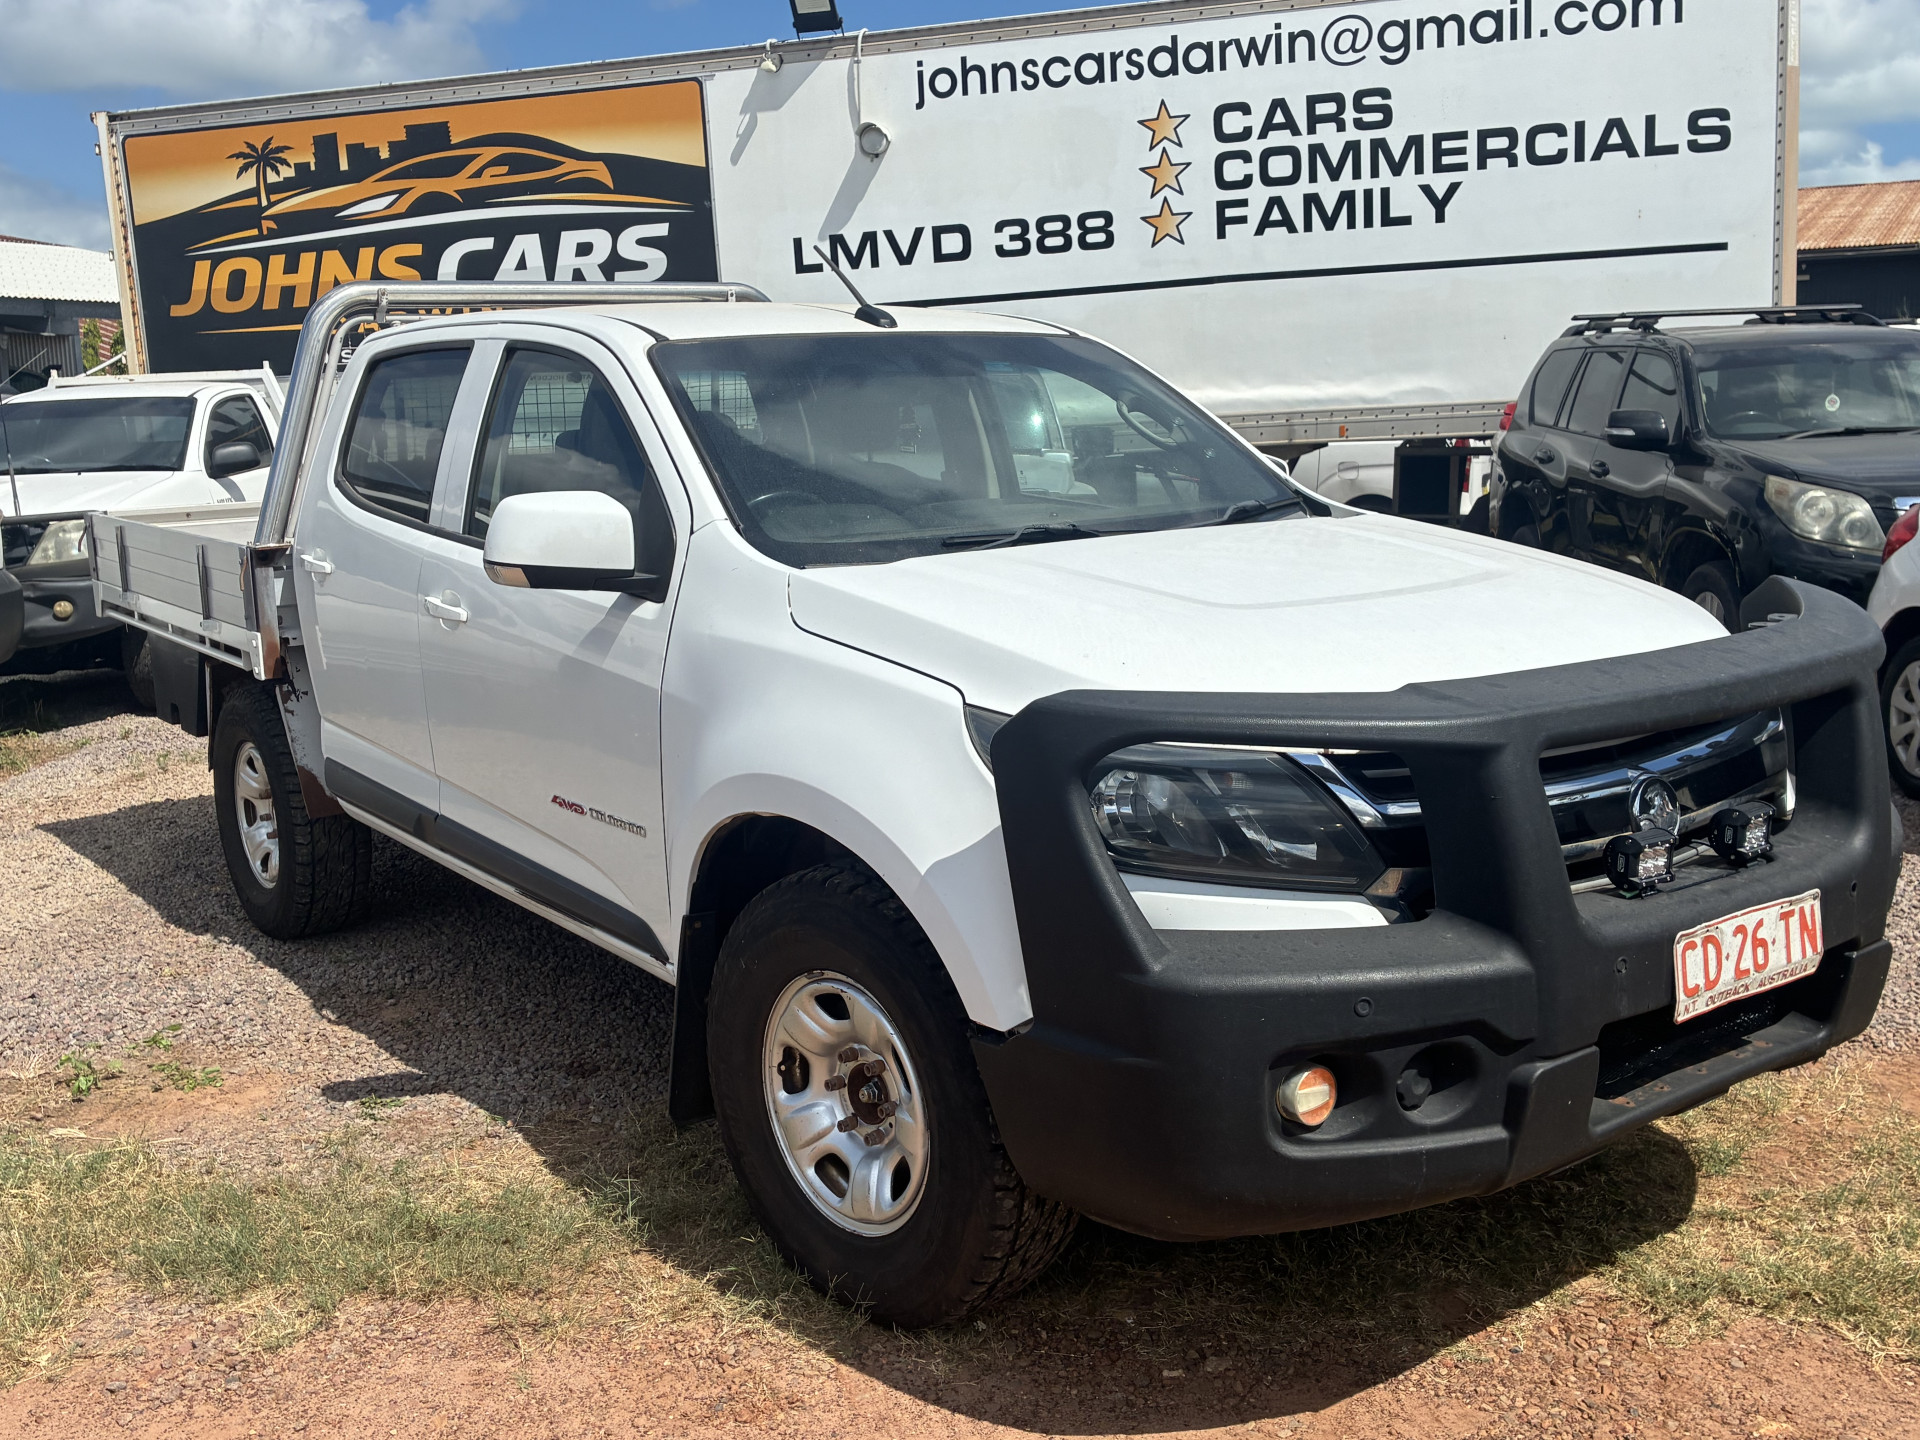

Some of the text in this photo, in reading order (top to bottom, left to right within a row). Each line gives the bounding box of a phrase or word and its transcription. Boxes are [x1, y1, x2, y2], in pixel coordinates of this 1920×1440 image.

[915, 0, 1683, 110] johnscarsdarwin@gmail.com
[1213, 87, 1393, 144] CARS
[1214, 108, 1731, 191] COMMERCIALS
[792, 210, 1115, 275] LMVD 388
[1216, 181, 1463, 240] FAMILY
[169, 222, 670, 317] JOHNS CARS
[1706, 982, 1750, 1007] OUTBACK
[1757, 962, 1809, 988] AUSTRALIA
